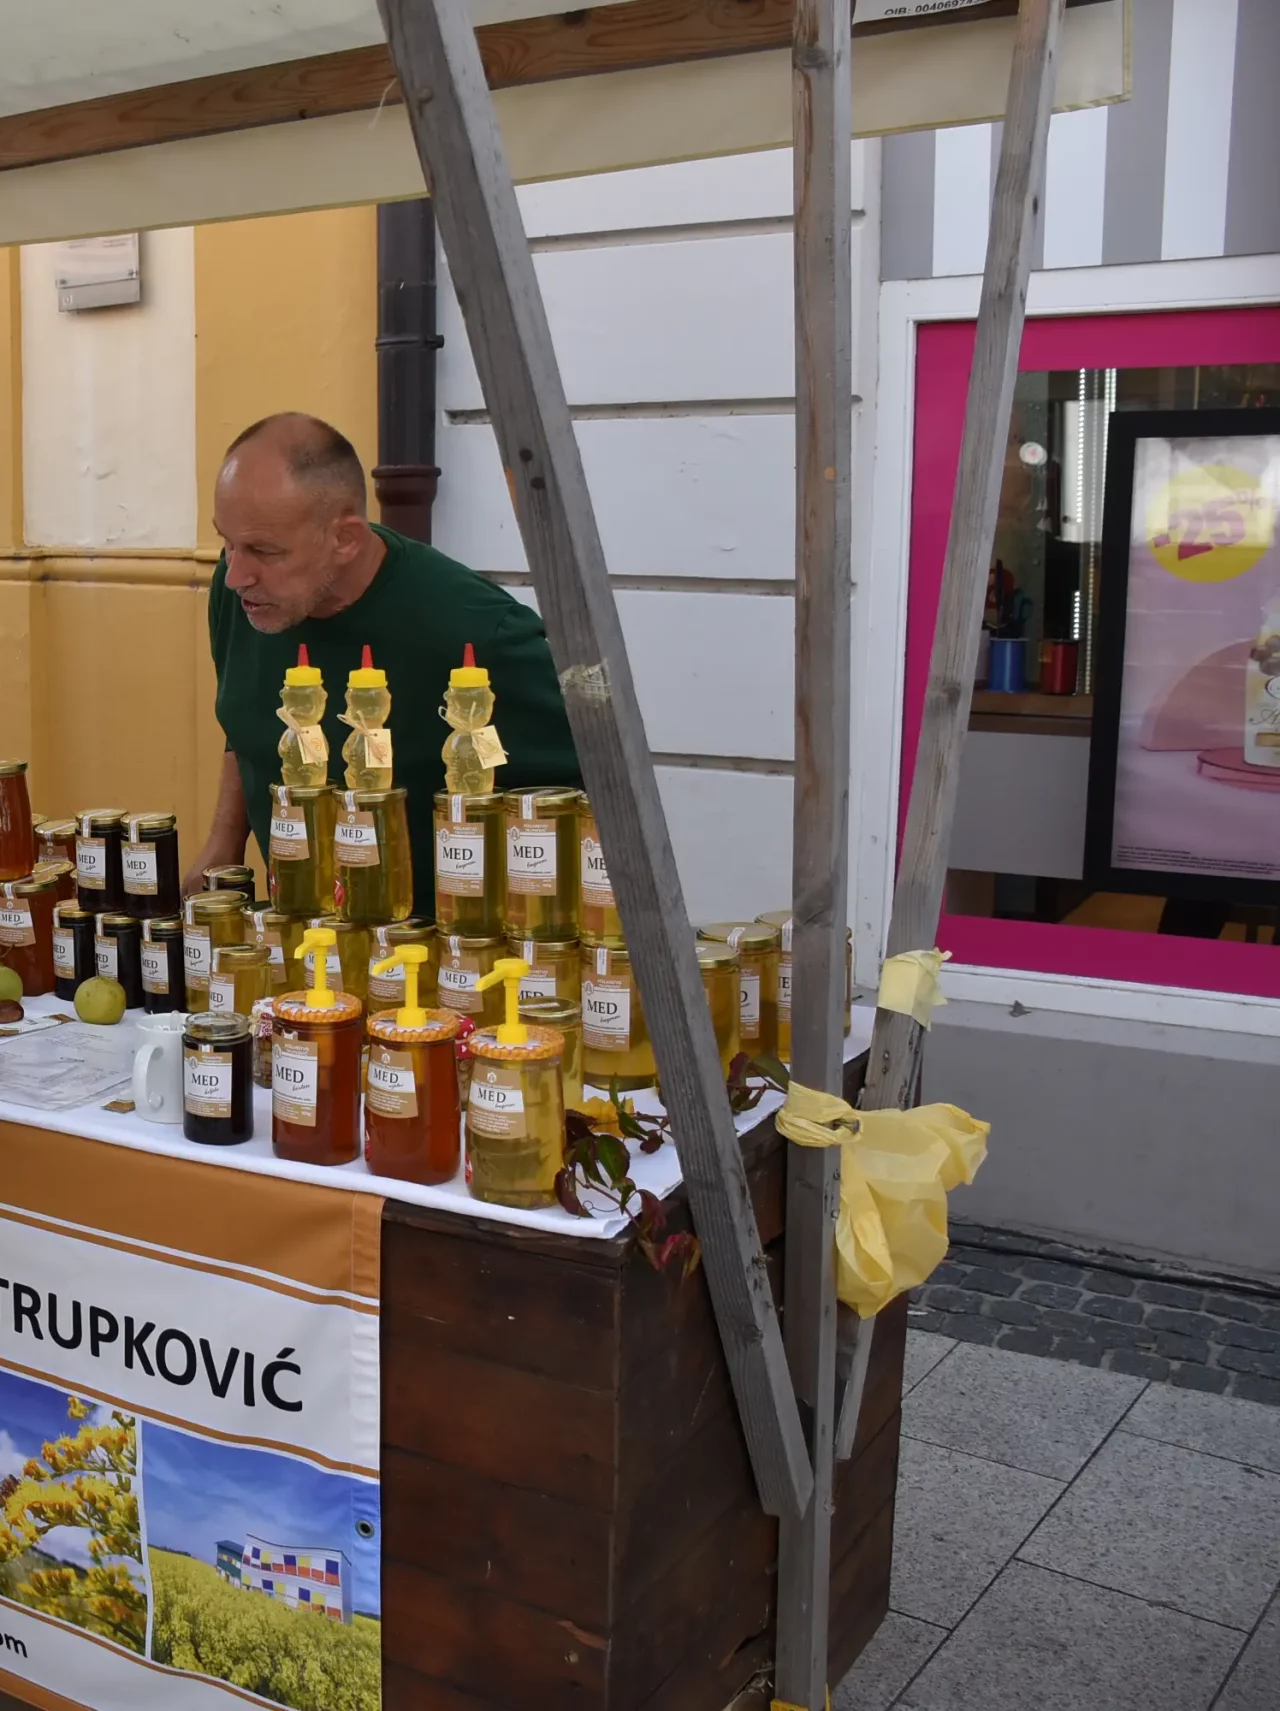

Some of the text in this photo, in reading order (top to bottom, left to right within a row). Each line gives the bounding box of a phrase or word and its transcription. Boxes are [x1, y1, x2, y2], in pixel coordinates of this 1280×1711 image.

[275, 822, 294, 833] MED
[341, 827, 363, 839] MED
[442, 846, 473, 861] MED
[513, 845, 545, 859] MED
[126, 859, 147, 870] MED
[587, 856, 607, 871] ME
[1, 912, 21, 923] MED
[142, 958, 158, 969] MED
[444, 971, 468, 984] MED
[587, 999, 618, 1015] MED
[191, 1072, 219, 1087] MED
[275, 1063, 304, 1084] MED
[374, 1067, 399, 1084] MED
[478, 1087, 507, 1104] MED
